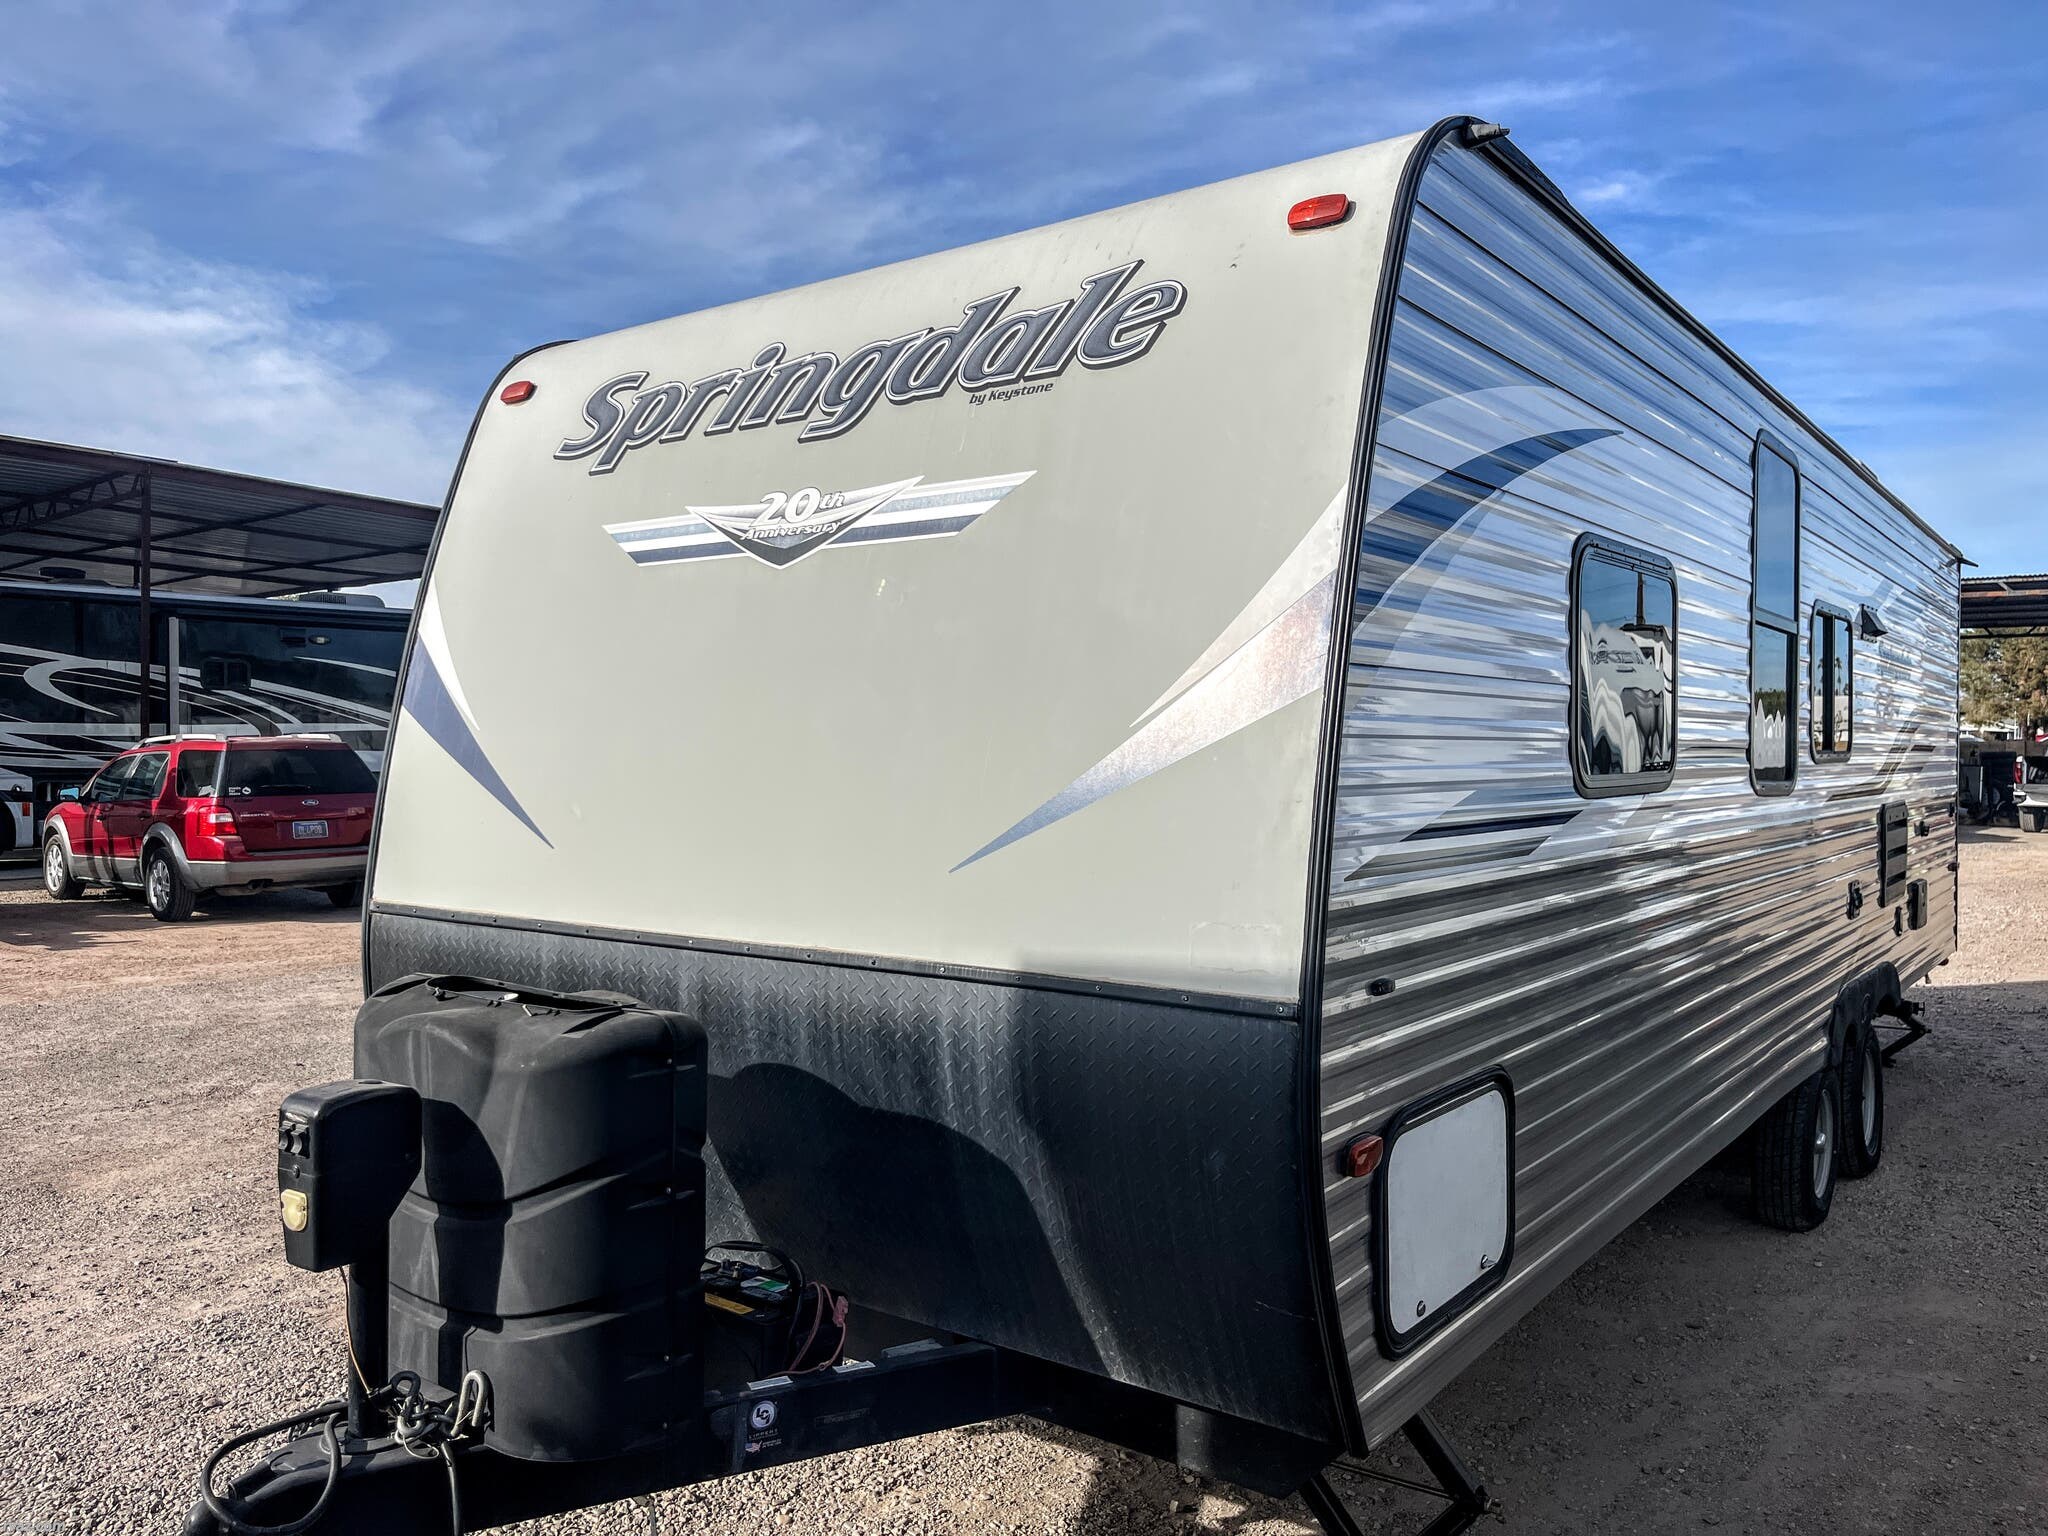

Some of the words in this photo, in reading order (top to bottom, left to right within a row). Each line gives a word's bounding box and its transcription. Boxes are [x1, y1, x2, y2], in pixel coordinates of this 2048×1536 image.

[553, 259, 1187, 475] Springdale
[969, 393, 986, 405] by
[988, 383, 1054, 401] Keystone
[749, 487, 846, 527] 20th
[740, 521, 841, 540] Anniversary
